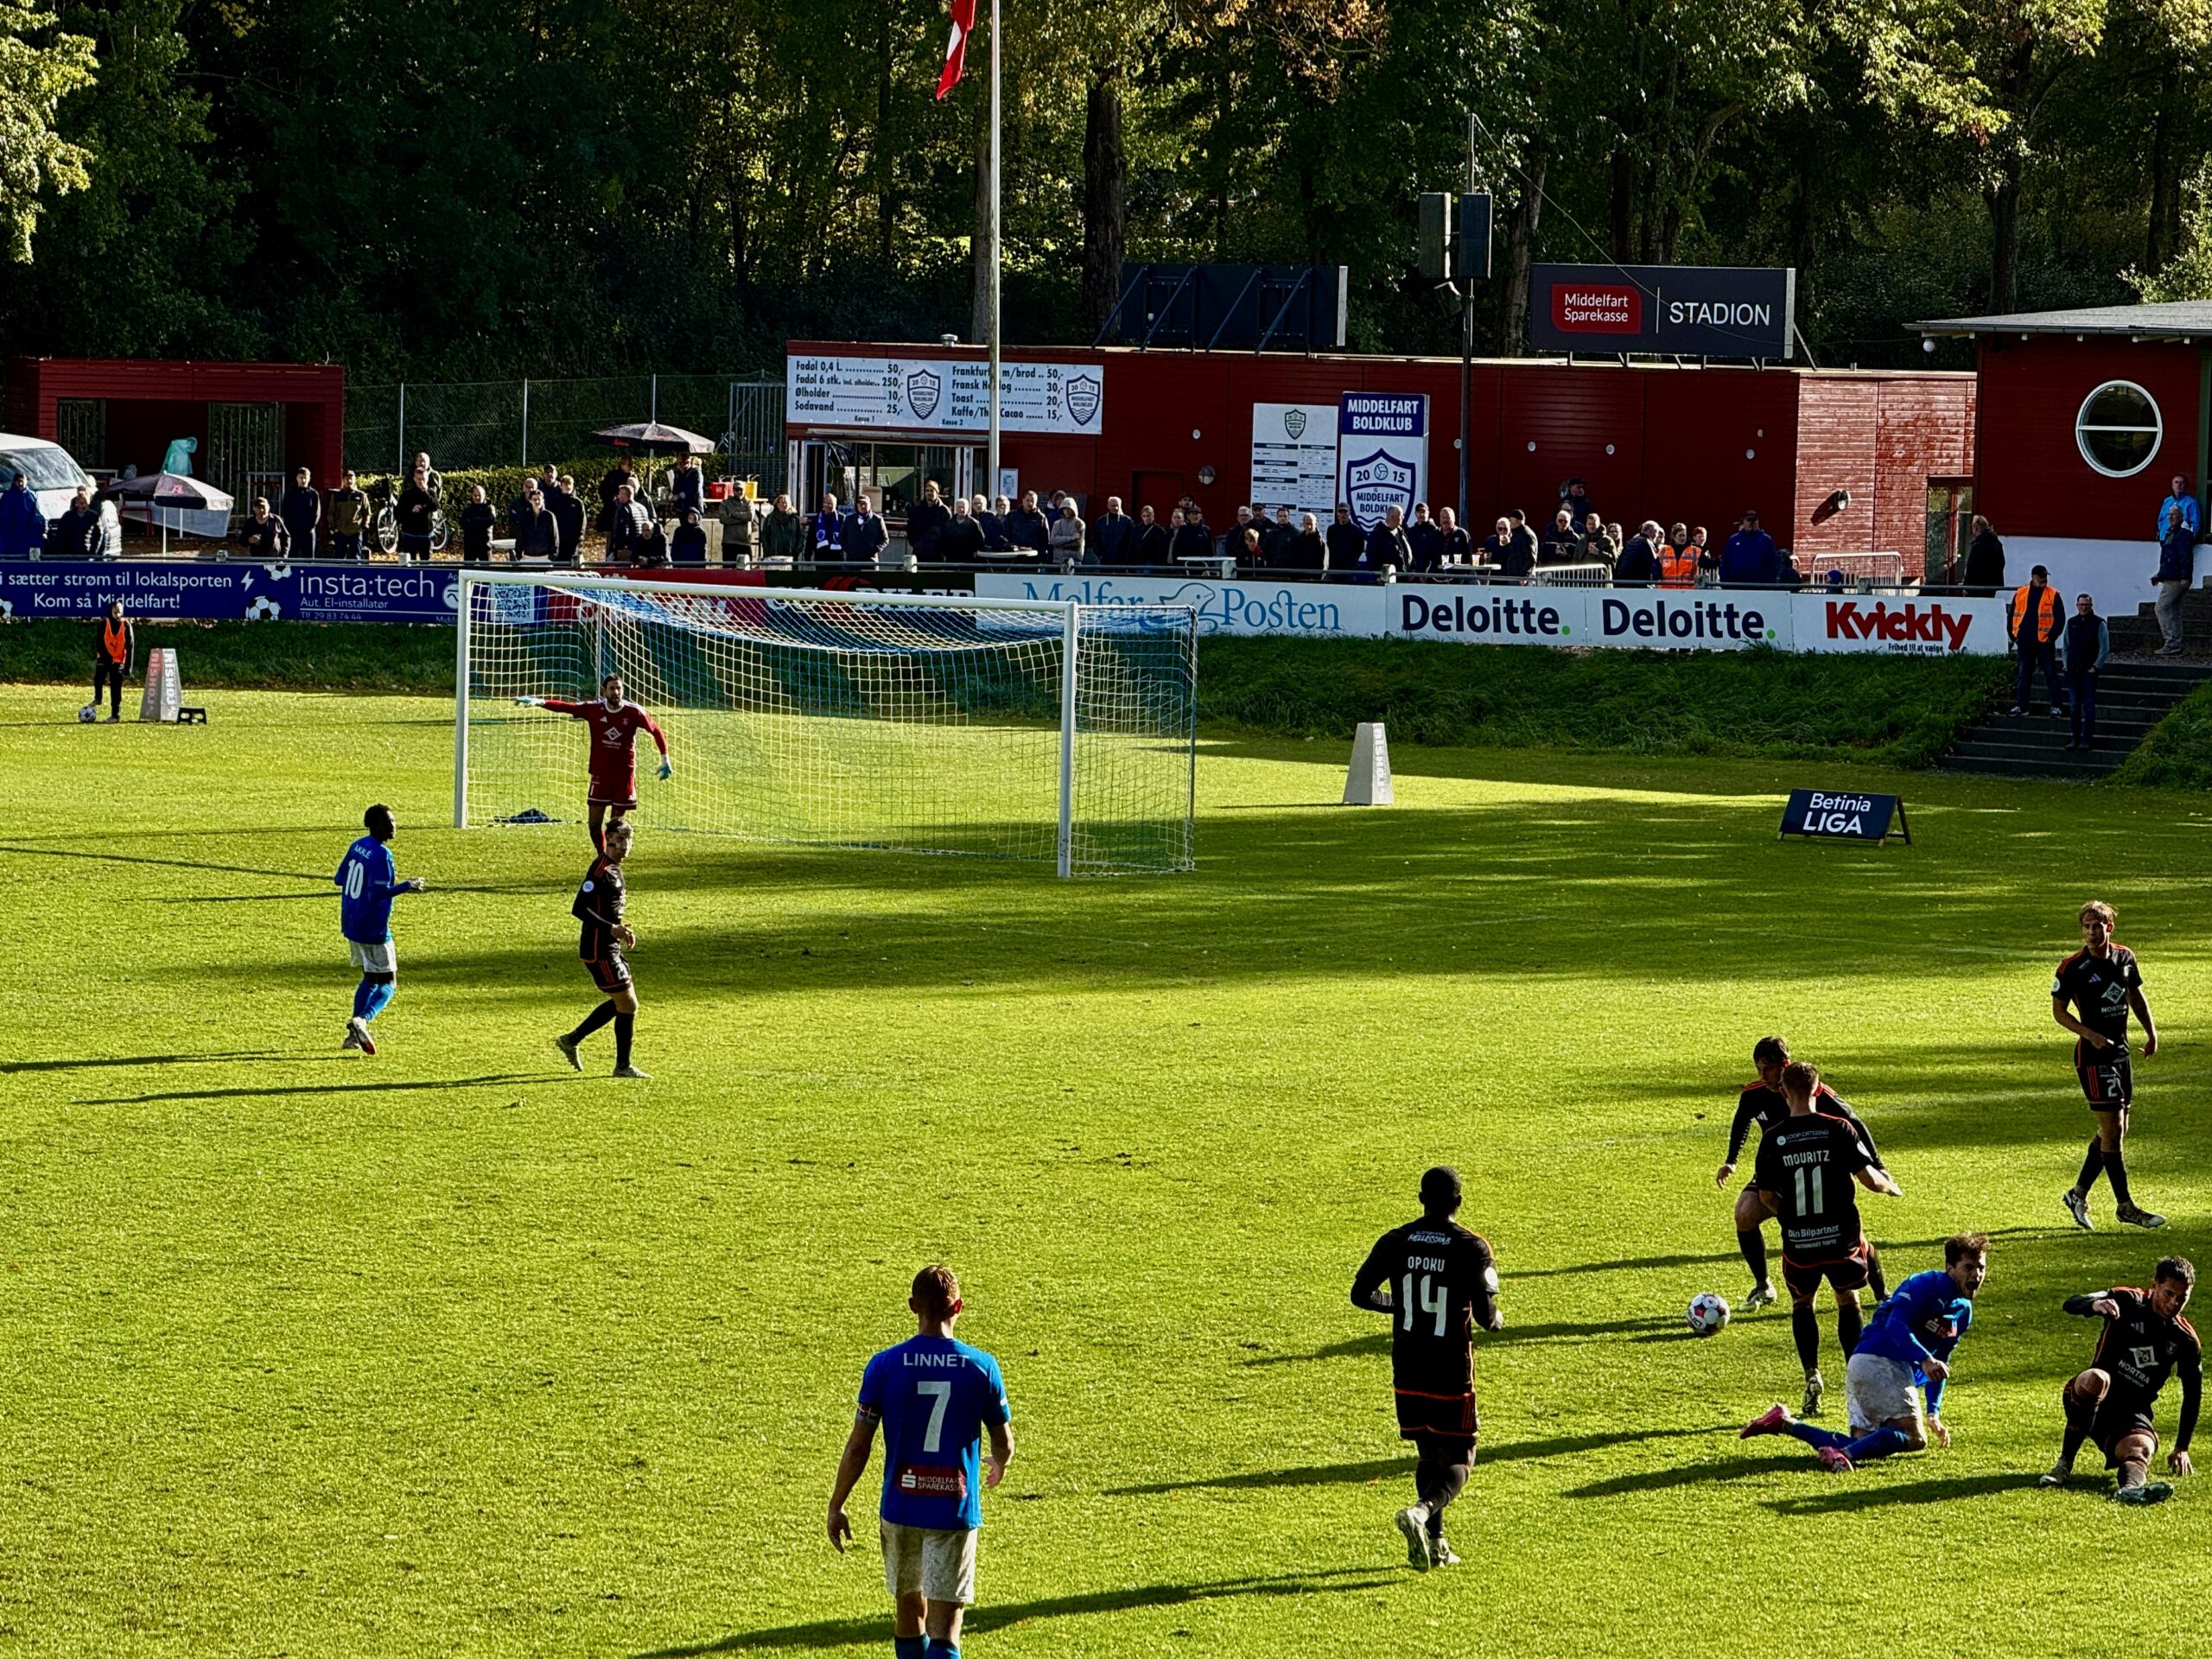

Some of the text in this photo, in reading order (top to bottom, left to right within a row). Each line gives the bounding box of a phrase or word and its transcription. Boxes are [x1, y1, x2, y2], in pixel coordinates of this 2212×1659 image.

[1564, 294, 1629, 308] Middelfart
[1564, 308, 1629, 323] Sparekasse
[1669, 302, 1770, 326] STADION
[820, 361, 834, 372] 0,4
[887, 364, 904, 376] 50,-
[1046, 368, 1064, 381] 50,-
[819, 374, 824, 385] 6
[826, 374, 841, 385] stk.
[882, 377, 904, 390] 250,-
[951, 379, 979, 390] Fransk
[1046, 382, 1064, 395] 30,-
[795, 387, 904, 403] Ølholder 10,-
[951, 393, 1063, 408] Toast 20,-
[795, 400, 903, 416] Sodavand 25,-
[951, 406, 989, 419] Kaffe/Th
[1047, 410, 1063, 422] 15,-
[1347, 399, 1420, 414] MIDDELFART
[1352, 416, 1413, 431] BOLDKLUB
[1356, 469, 1370, 482] 20
[1393, 471, 1406, 483] 15
[1356, 492, 1405, 503] MIDDELFART
[1359, 503, 1388, 513] BOLDKL
[9, 574, 60, 586] sætter
[64, 574, 111, 586] strøm
[115, 570, 130, 586] til
[136, 570, 232, 591] lokalsporten
[300, 569, 435, 597] insta:tech
[35, 592, 180, 608] Kom så Middelfart!
[324, 597, 389, 609] El-installatør
[314, 612, 325, 620] 29
[327, 612, 337, 620] 83
[339, 612, 350, 620] 74
[1220, 588, 1340, 630] Posten
[1825, 601, 1973, 650] Kvickly
[1888, 643, 1908, 652] Frihed
[1924, 644, 1944, 653] vælge
[1809, 792, 1872, 812] Betinia
[1802, 810, 1863, 835] LIGA
[344, 858, 364, 899] 10
[1783, 1149, 1830, 1167] MOURITZ
[1794, 1165, 1823, 1217] 11
[1788, 1224, 1840, 1238] Din Bilpartner
[1408, 1255, 1446, 1273] OPOKU
[1402, 1272, 1448, 1338] 14
[903, 1352, 969, 1368] LINNET
[2118, 1359, 2151, 1385] NORTRA
[917, 1381, 951, 1453] 7
[918, 1475, 959, 1484] MIDDELFAR
